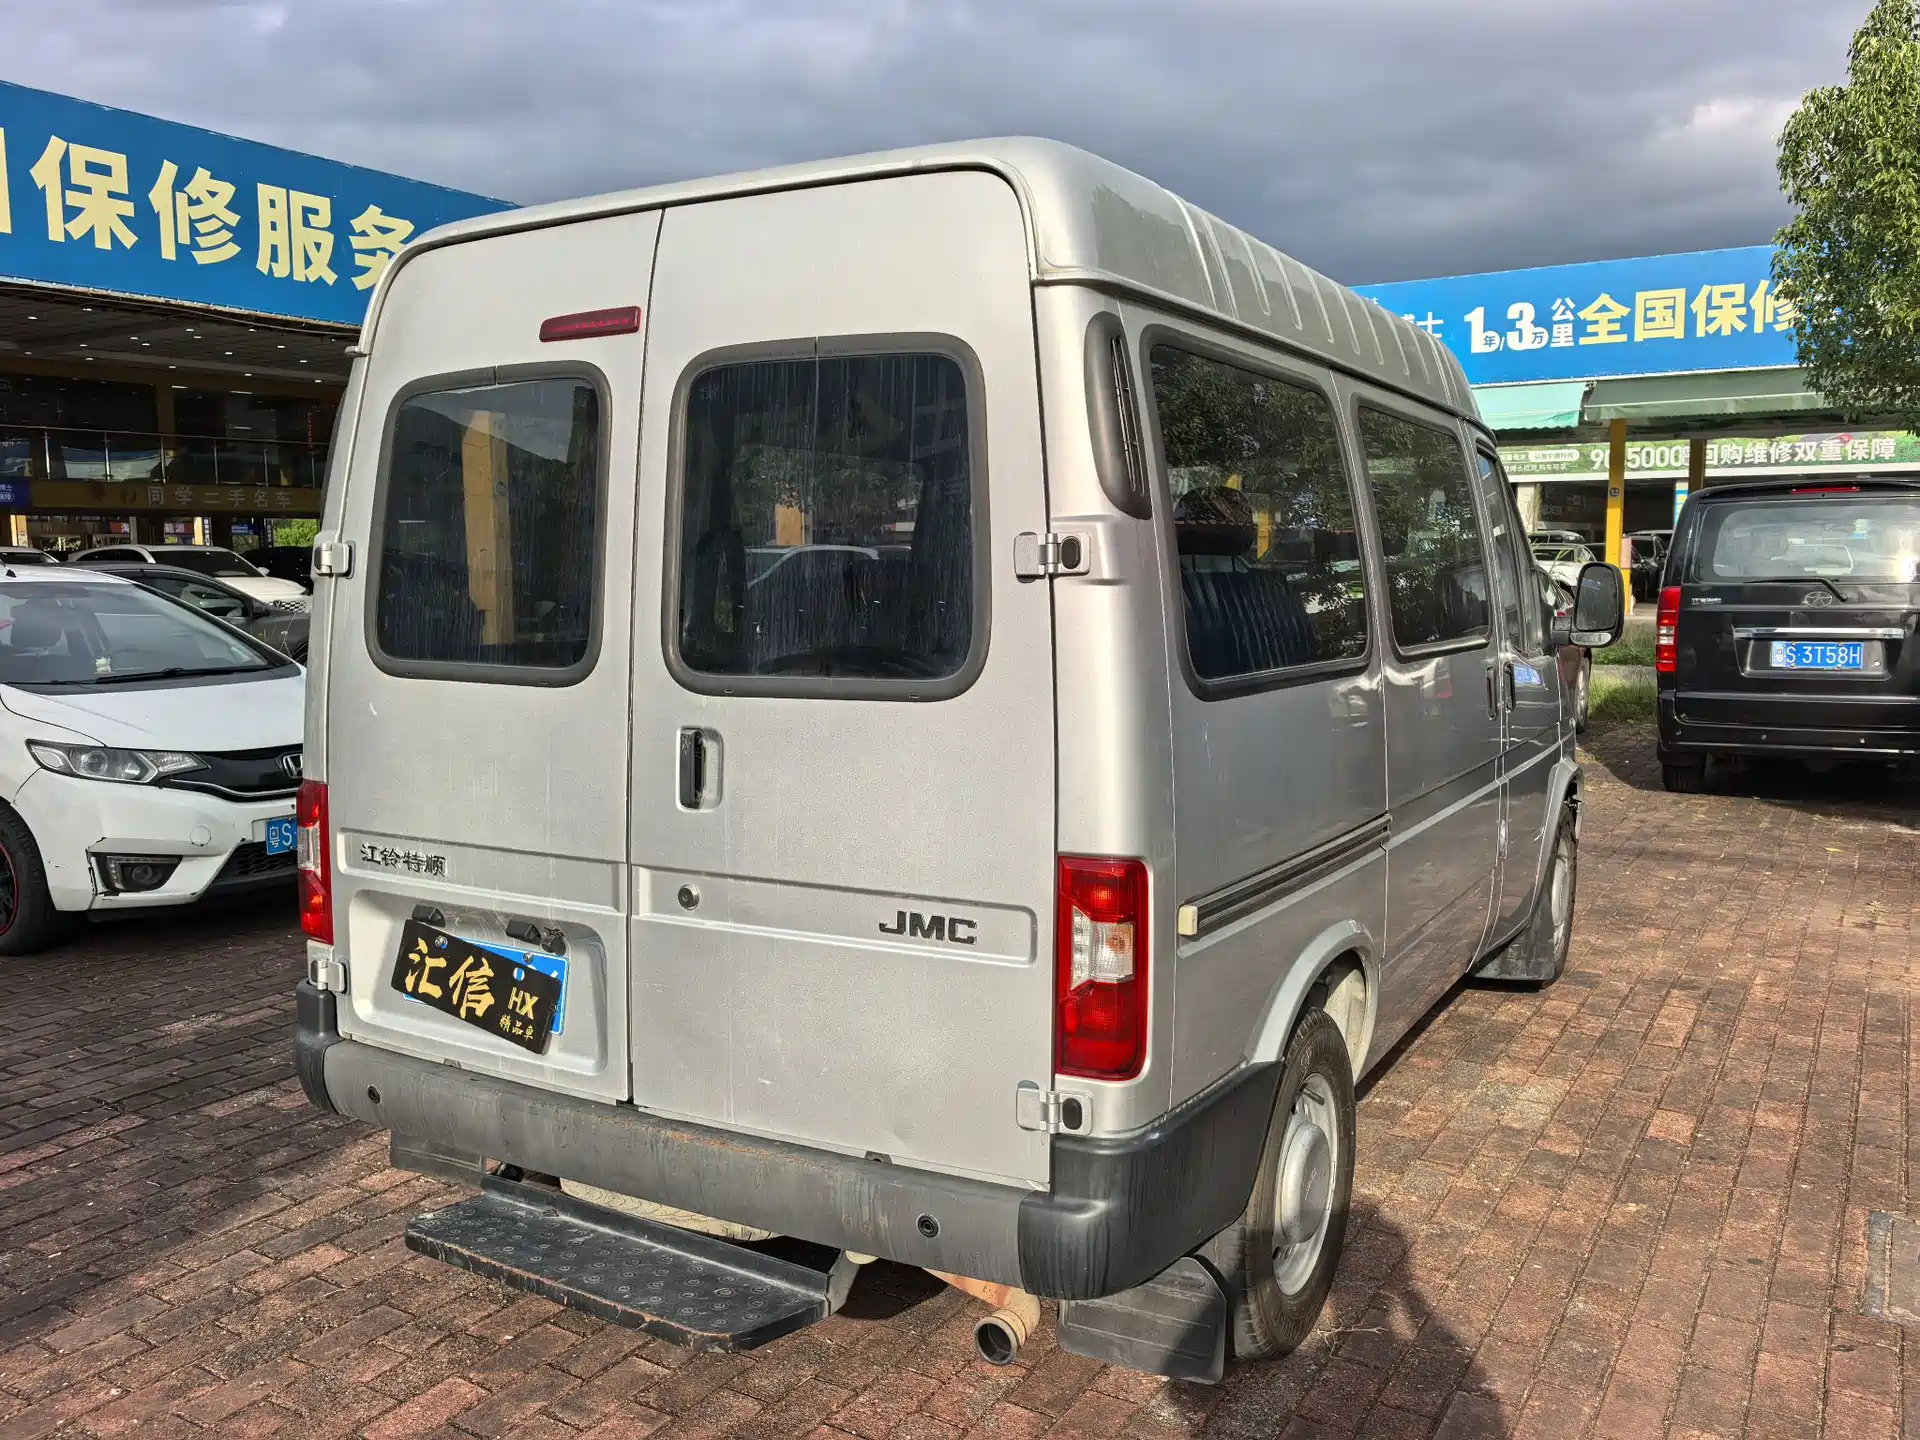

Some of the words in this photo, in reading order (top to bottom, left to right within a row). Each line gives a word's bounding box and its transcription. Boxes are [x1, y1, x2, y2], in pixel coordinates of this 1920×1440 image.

[0, 127, 414, 291] 保修服务
[1400, 312, 1444, 338] 士
[361, 843, 448, 877] 江铃特顺
[879, 910, 977, 945] JMC
[405, 937, 495, 1020] 汇信
[508, 986, 539, 1020] HX
